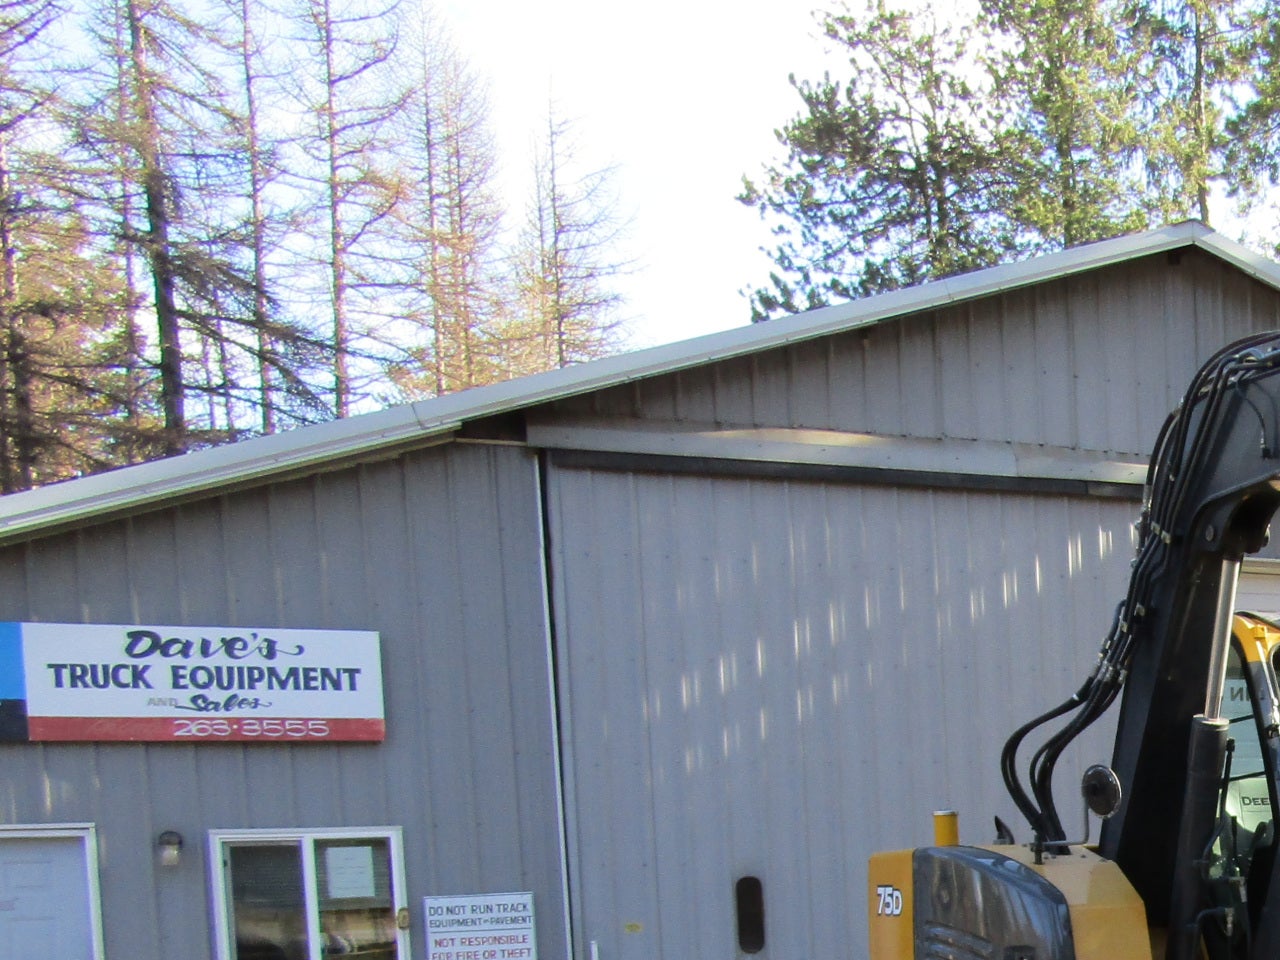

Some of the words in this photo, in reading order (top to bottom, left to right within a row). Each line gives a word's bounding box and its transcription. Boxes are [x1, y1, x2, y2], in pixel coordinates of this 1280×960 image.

[123, 629, 305, 660] Dave's
[47, 663, 154, 689] TRUCK
[171, 664, 361, 692] EQUIPMENT
[147, 697, 178, 708] AND
[176, 693, 272, 712] Sales
[1241, 796, 1270, 806] DEE
[877, 886, 902, 915] 75D
[429, 907, 444, 917] DO
[447, 906, 466, 916] NOT
[472, 905, 493, 915] RUN
[497, 903, 529, 914] TRACK
[430, 918, 482, 929] EQUIPMENT
[491, 916, 532, 926] PAVEMENT
[435, 938, 456, 948] NOT
[461, 935, 529, 947] RESPONSIBLE
[457, 951, 480, 960] FIRE
[483, 950, 497, 960] OR
[501, 948, 531, 958] THEFT
